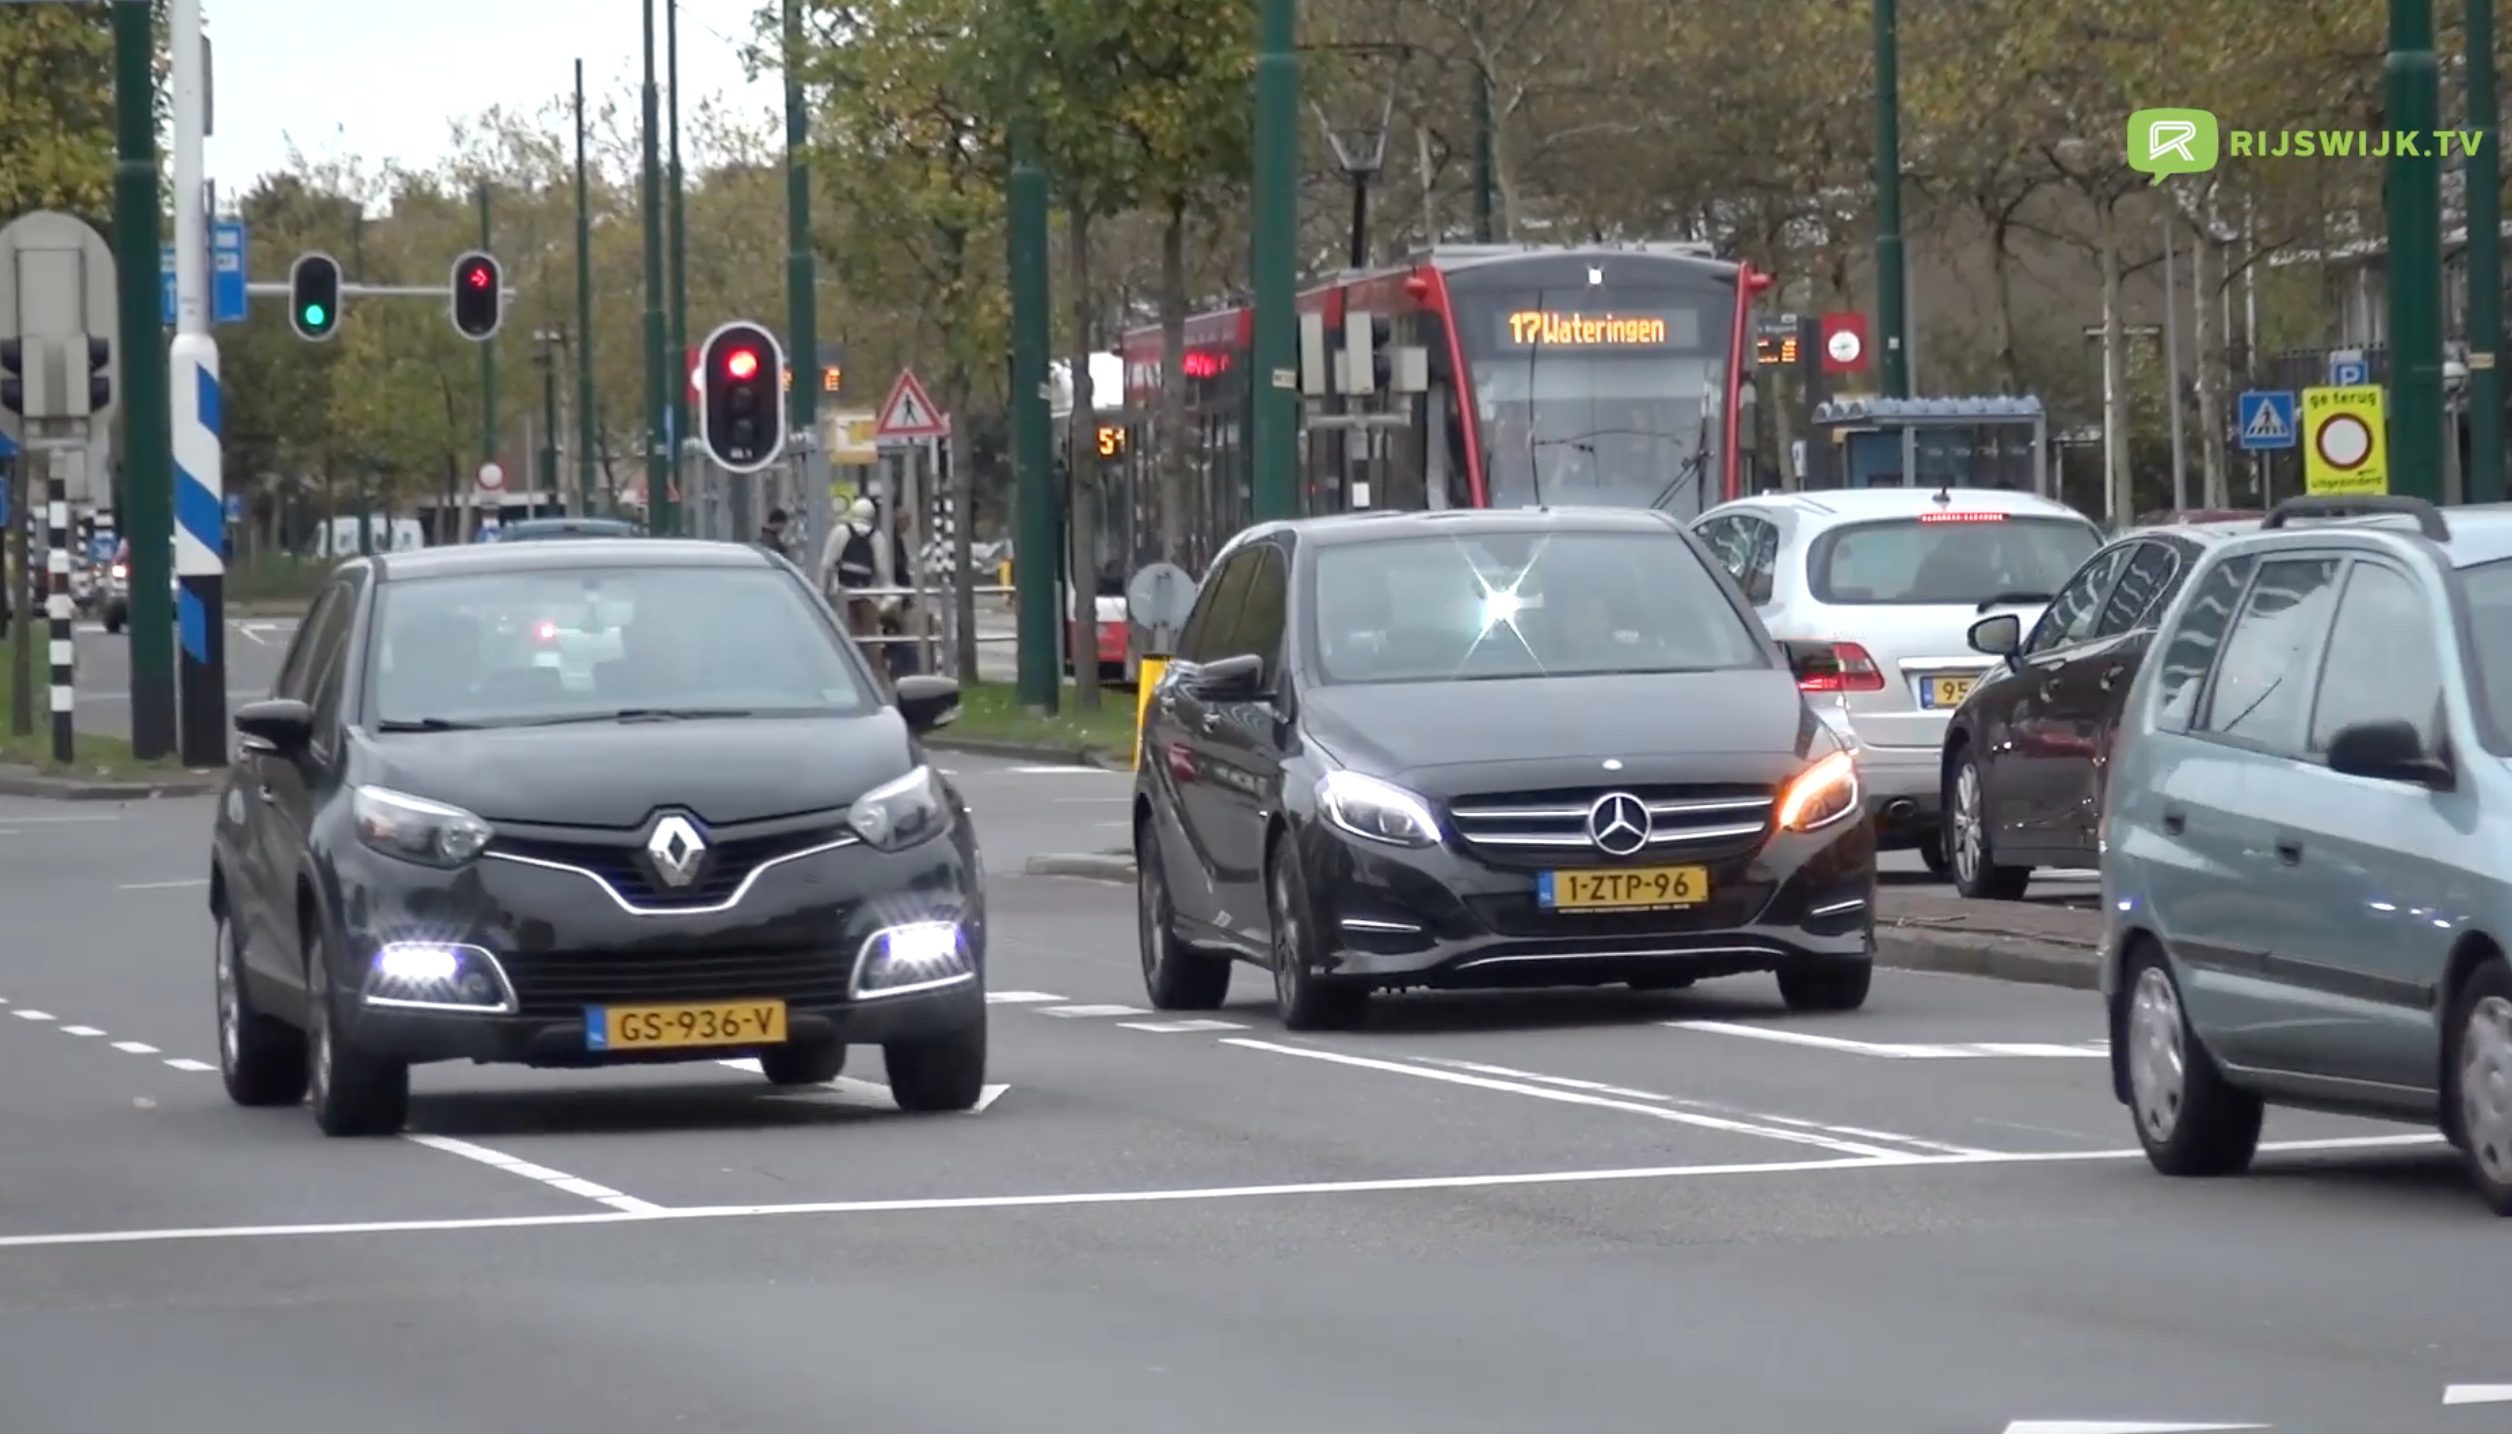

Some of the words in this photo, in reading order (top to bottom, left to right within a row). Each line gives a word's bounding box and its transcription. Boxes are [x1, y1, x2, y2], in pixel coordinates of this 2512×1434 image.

[1509, 311, 1541, 344] 17
[1542, 311, 1665, 344] Wateringen
[2340, 365, 2360, 387] P
[1568, 871, 1690, 901] 1-ZTP-96
[621, 1007, 773, 1041] GS-936-V
